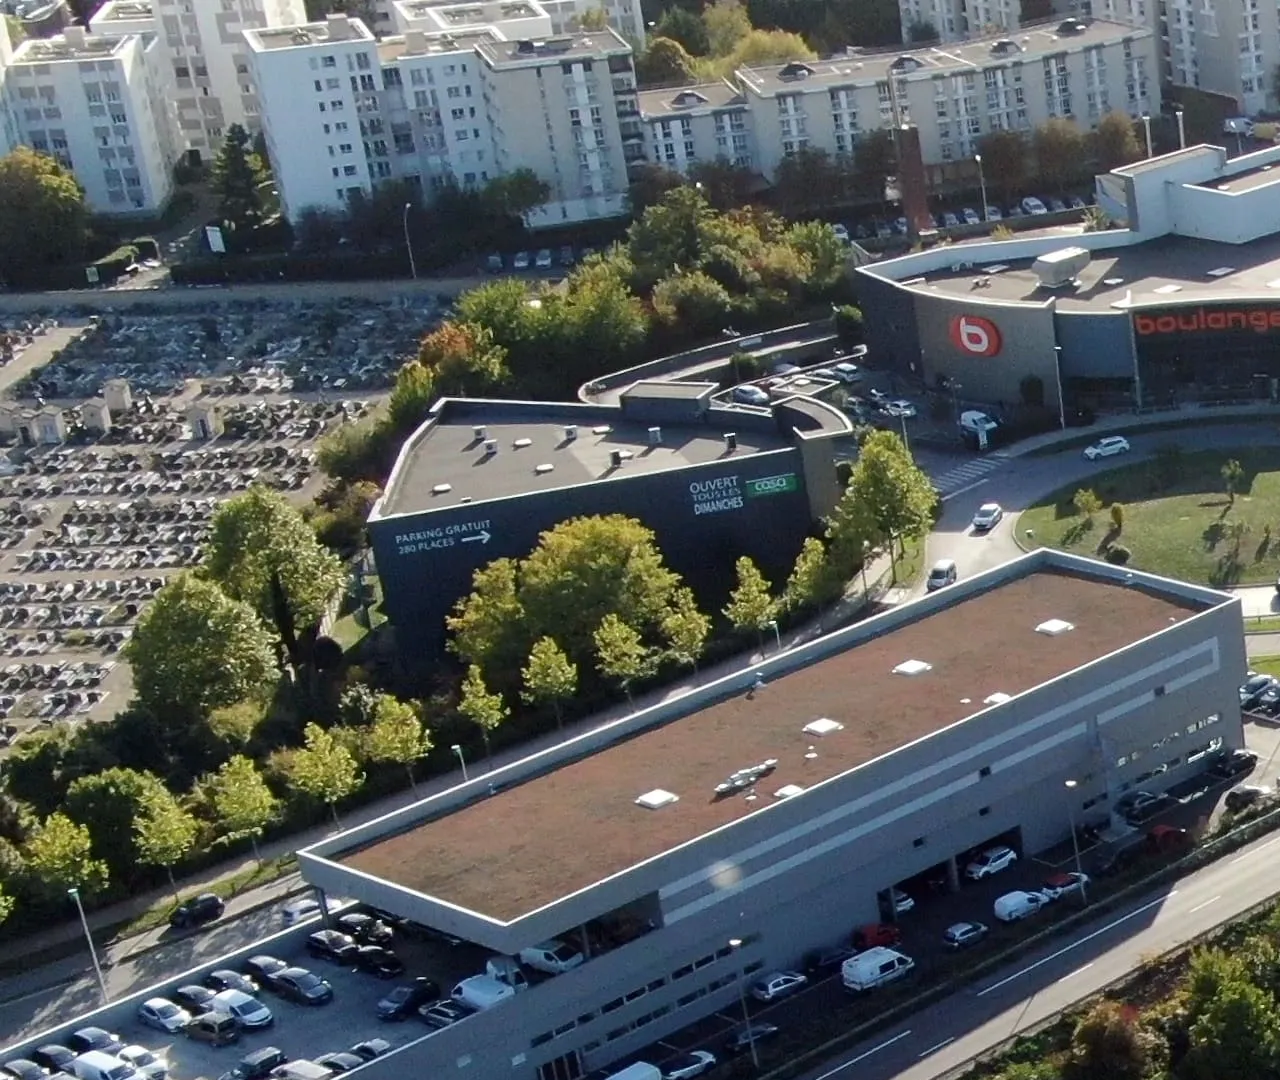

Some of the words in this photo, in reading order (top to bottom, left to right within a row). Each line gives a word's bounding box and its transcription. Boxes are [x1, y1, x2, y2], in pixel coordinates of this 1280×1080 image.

[959, 316, 989, 353] b
[689, 475, 739, 494] OUVERT
[692, 490, 720, 502] TOUS
[694, 496, 744, 515] DIMANCHES
[395, 528, 443, 544] PARKING
[445, 519, 491, 535] GRATUIT
[418, 538, 455, 551] PLACES
